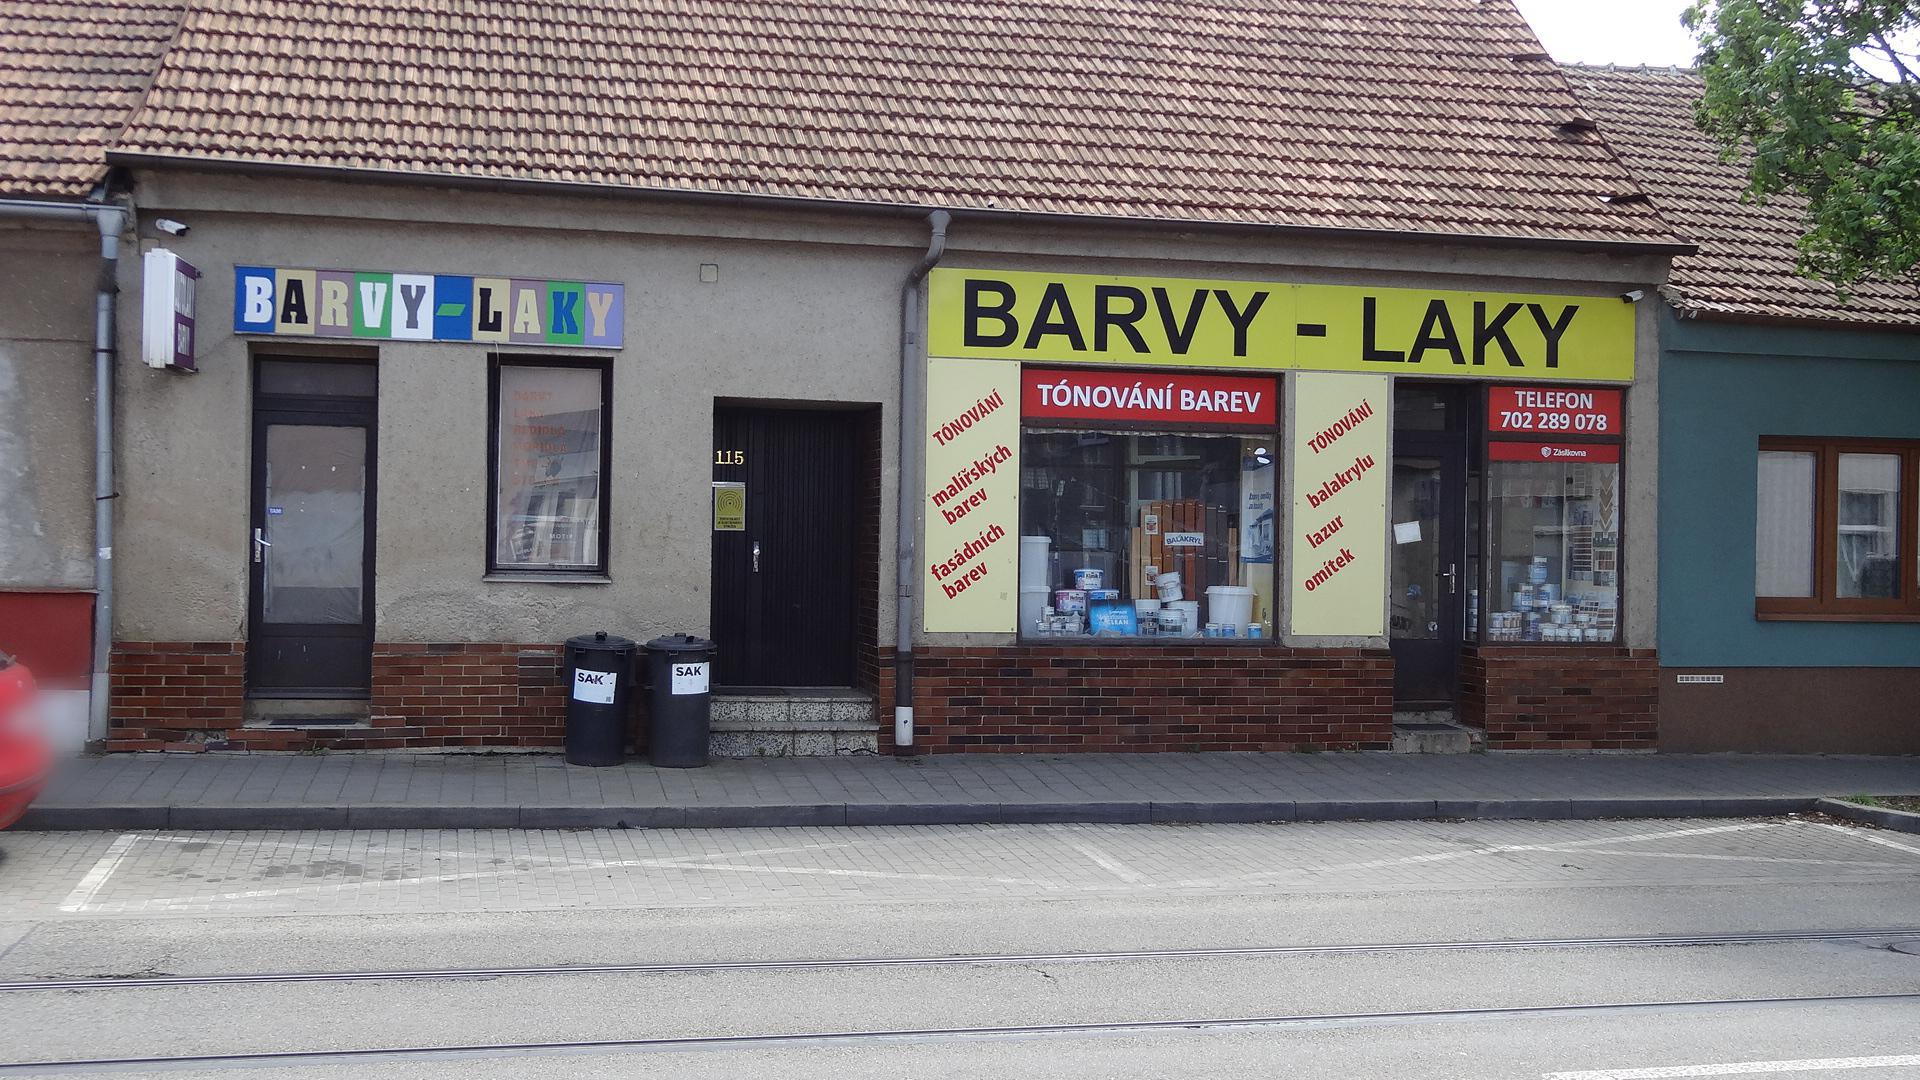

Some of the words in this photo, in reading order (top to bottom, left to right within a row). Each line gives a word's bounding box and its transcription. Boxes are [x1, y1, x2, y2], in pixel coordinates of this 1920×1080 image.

[963, 279, 1270, 358] BARVY
[1362, 296, 1580, 369] LAKY
[1037, 379, 1175, 410] TÓNOVÁNÍ
[1180, 389, 1262, 413] BAREV
[1514, 390, 1593, 410] TELEFON
[932, 388, 1004, 447] TÓNOVÁNÍ
[1307, 398, 1374, 454] TÓNOVÁNÍ
[1500, 411, 1533, 429] 702
[1538, 412, 1570, 430] 289
[1574, 413, 1607, 431] 078
[715, 450, 744, 465] 115
[931, 444, 1013, 508] malířských
[1306, 454, 1375, 509] balakrylu
[942, 487, 988, 526] barev
[1305, 514, 1344, 549] lazur
[931, 523, 1006, 582] fasádních
[1304, 547, 1356, 592] omítek
[942, 561, 988, 600] barev
[577, 672, 604, 685] SAK
[676, 665, 702, 677] SAK
